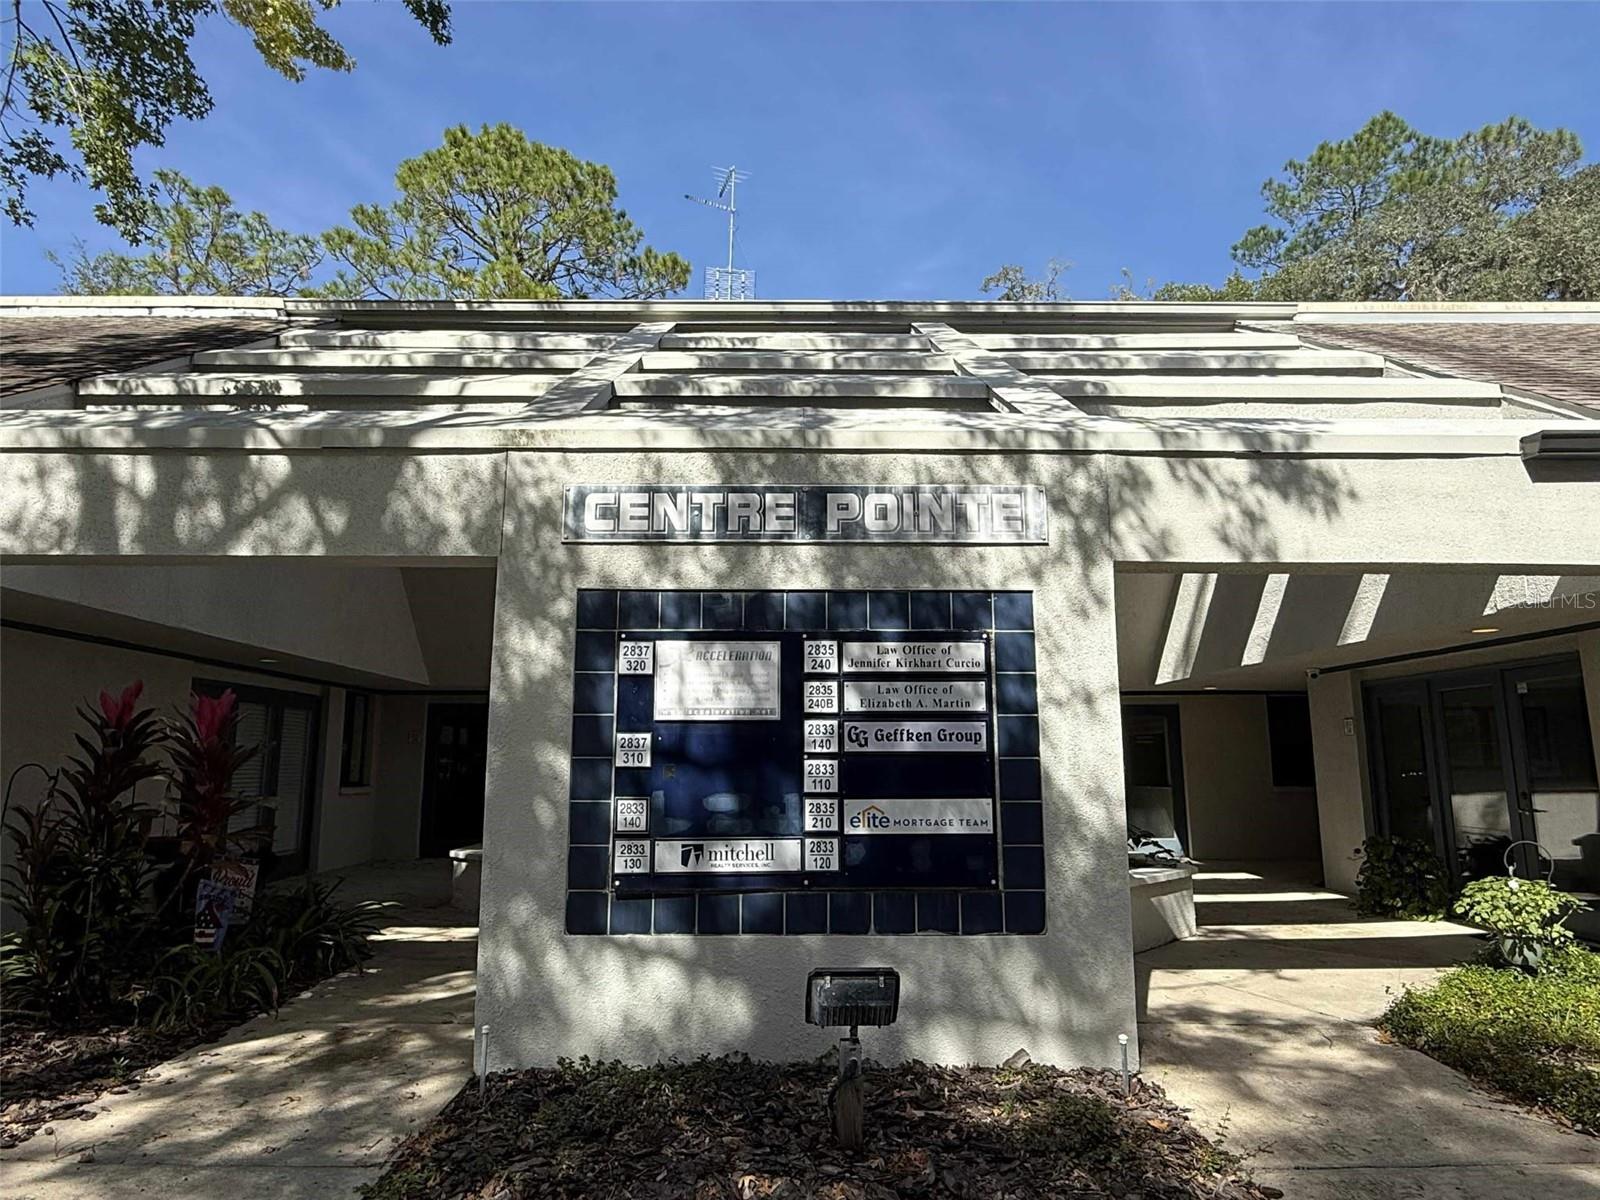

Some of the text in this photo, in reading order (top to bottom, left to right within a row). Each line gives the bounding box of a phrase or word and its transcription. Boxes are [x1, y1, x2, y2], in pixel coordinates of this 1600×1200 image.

[583, 492, 1025, 536] CENTRE POINTE
[623, 645, 650, 656] 2837
[808, 644, 835, 655] 2835
[876, 645, 952, 655] Law Office of
[695, 650, 773, 662] ACCELERATION
[626, 660, 646, 671] 320
[811, 659, 831, 670] 240
[848, 658, 981, 669] Jennifer Kirkhart Curcio
[809, 685, 833, 695] 2835
[877, 685, 954, 695] Law Office of
[808, 699, 834, 709] 240B
[860, 698, 971, 708] Elizabeth A. Martin
[808, 724, 835, 736] 2833
[874, 728, 932, 743] Geffken
[937, 728, 982, 745] Group
[620, 737, 647, 749] 2837
[812, 739, 832, 750] 140
[623, 753, 644, 764] 310
[808, 764, 835, 775] 2833
[812, 779, 831, 790] 110
[619, 803, 645, 814] 2833
[809, 803, 835, 814] 2835
[623, 817, 641, 828] 140
[812, 817, 832, 828] 210
[893, 818, 955, 827] MORTGAGE
[960, 818, 989, 827] TEAM
[620, 844, 646, 855] 2833
[708, 842, 775, 861] mitchell
[810, 841, 834, 853] 2833
[623, 858, 642, 869] 130
[813, 857, 832, 869] 120
